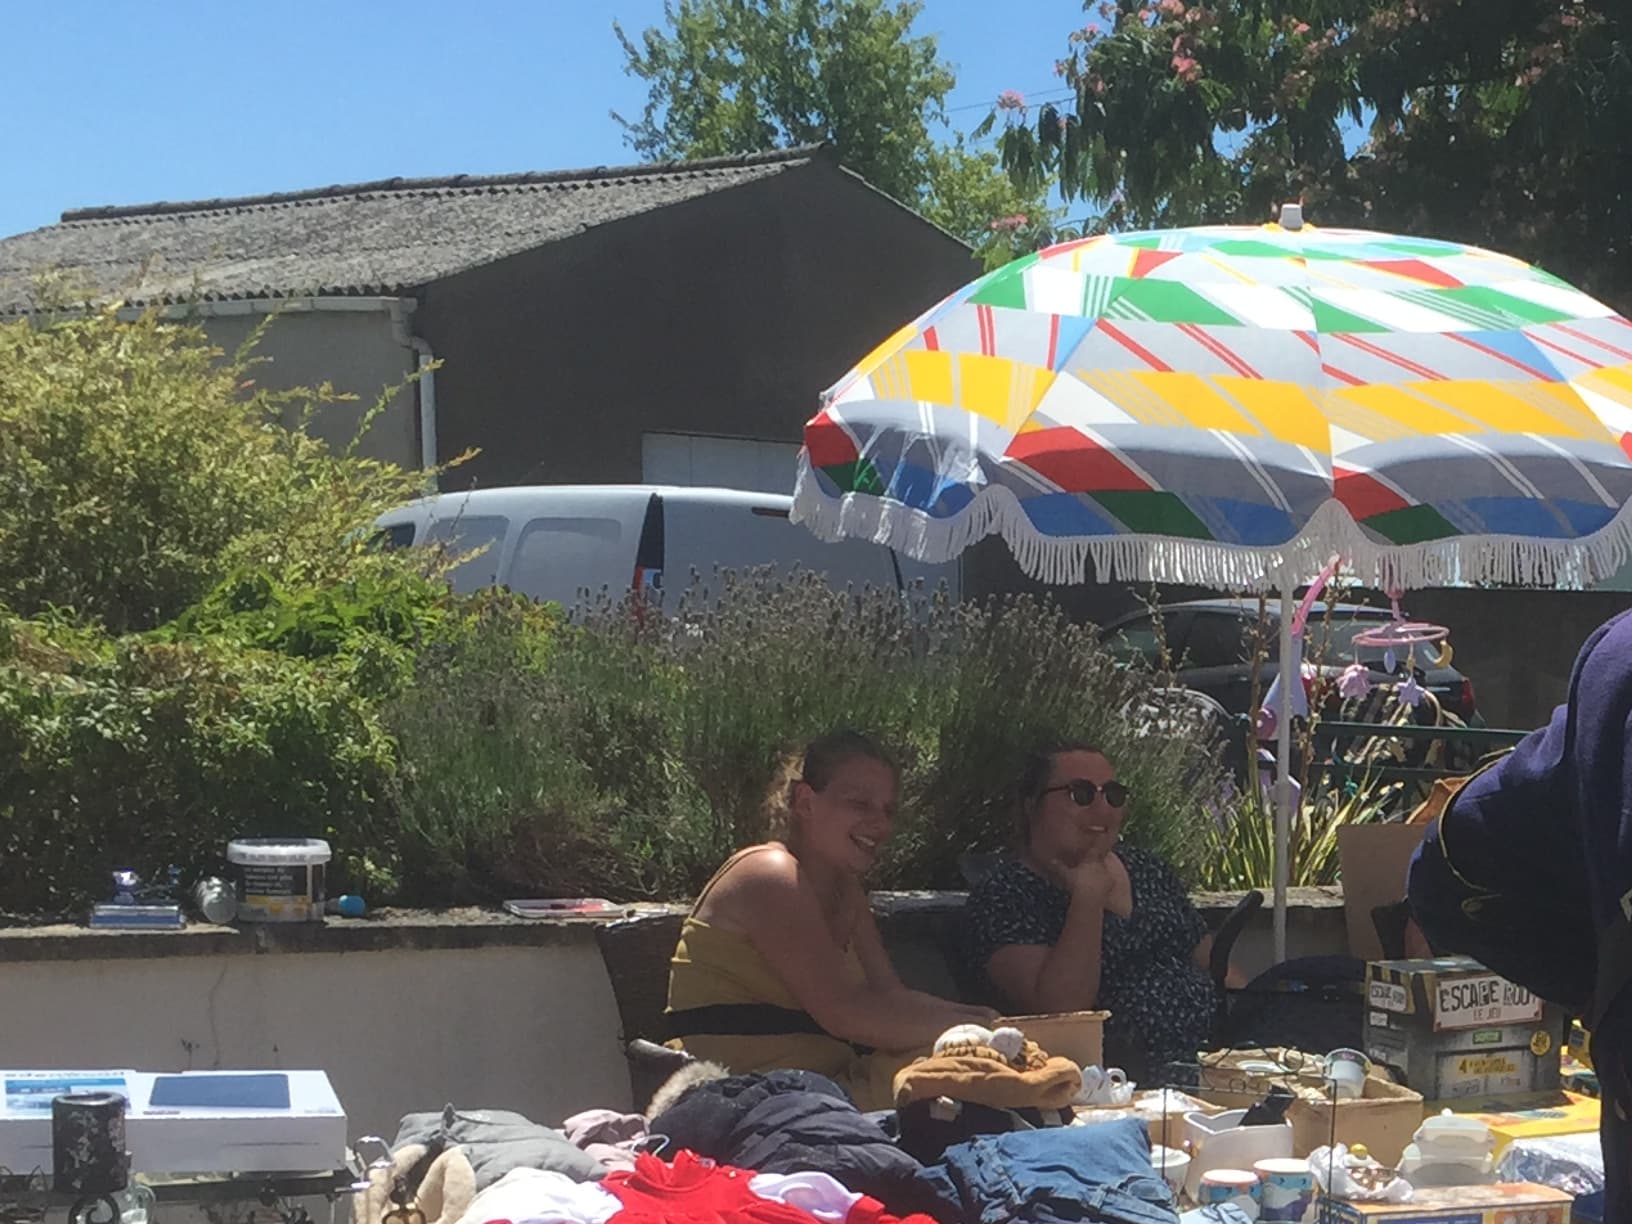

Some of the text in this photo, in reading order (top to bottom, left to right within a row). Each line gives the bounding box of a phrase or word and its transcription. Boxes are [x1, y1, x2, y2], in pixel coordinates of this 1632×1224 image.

[1440, 979, 1538, 1013] ESCAPE ROO
[1473, 1006, 1501, 1022] LE JEU
